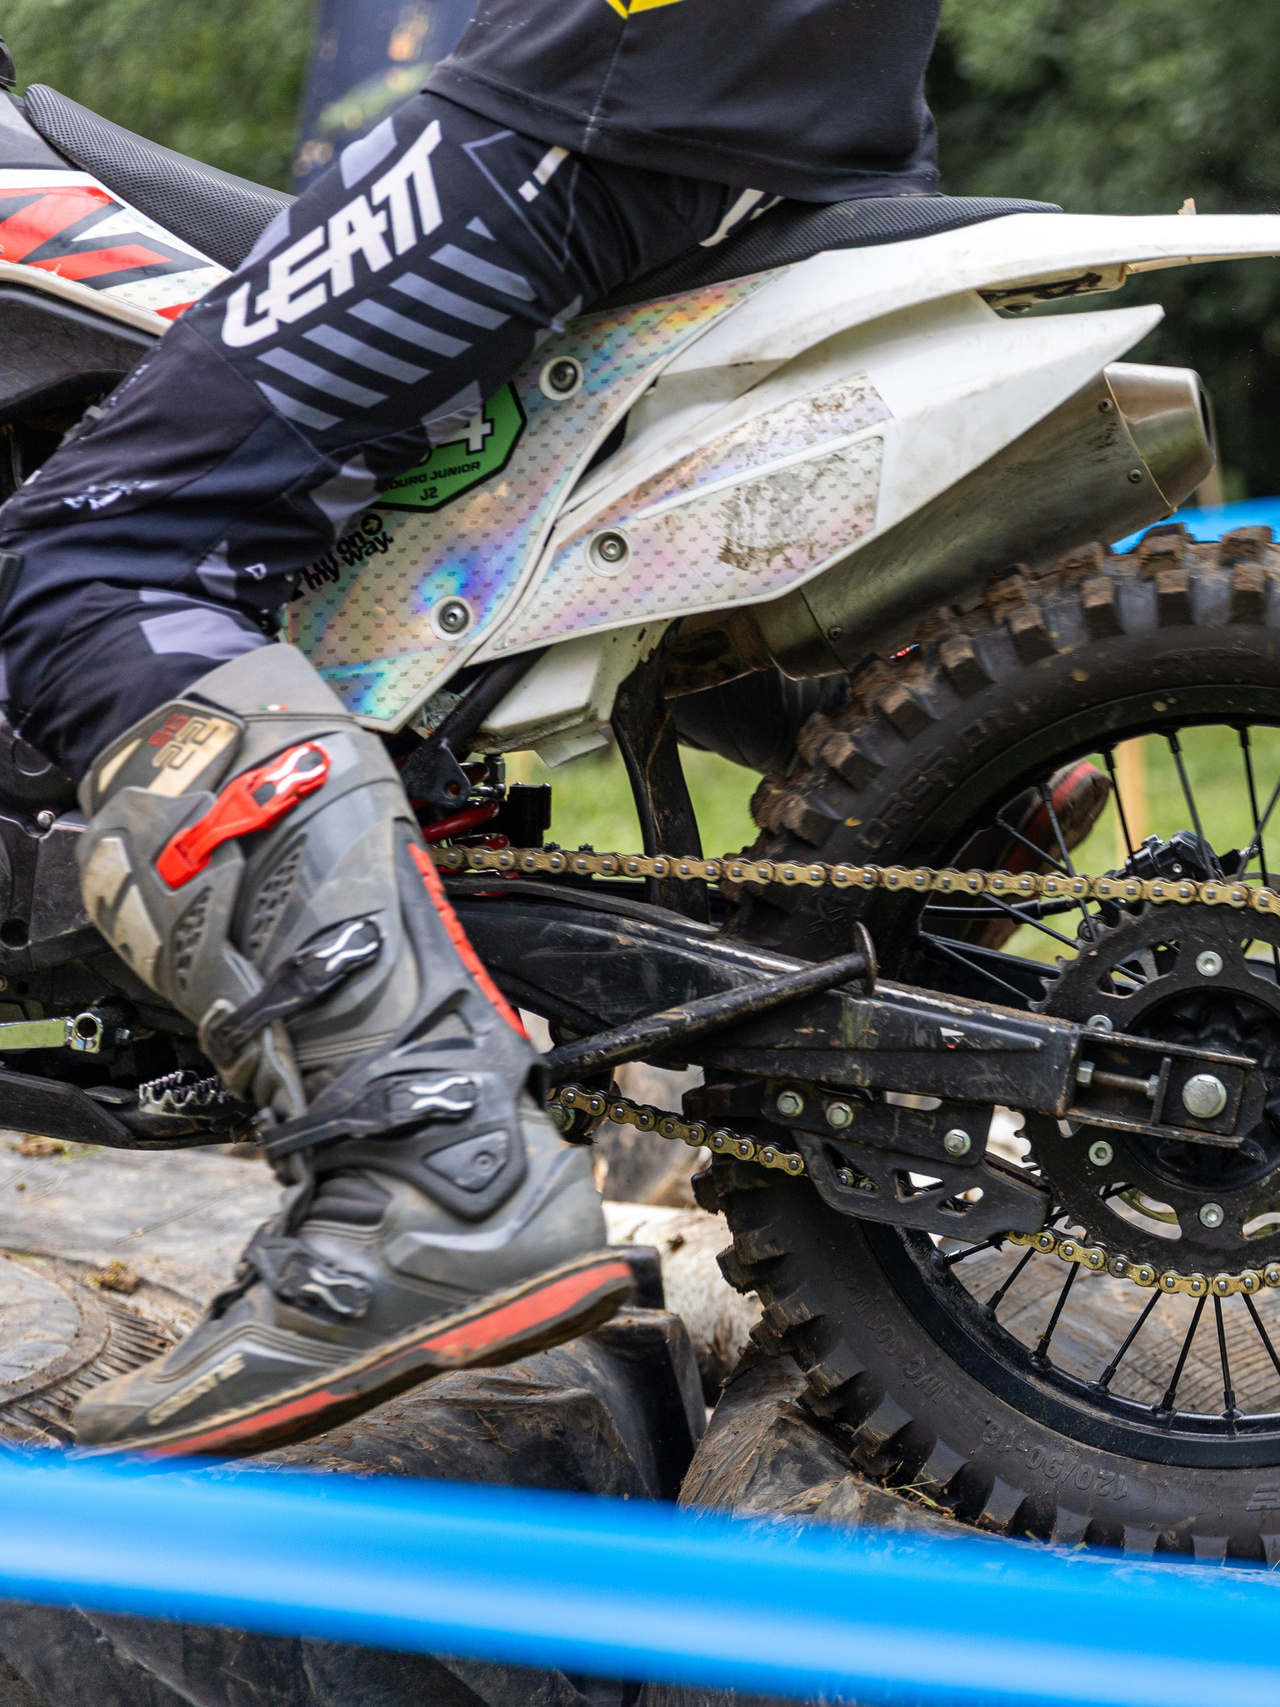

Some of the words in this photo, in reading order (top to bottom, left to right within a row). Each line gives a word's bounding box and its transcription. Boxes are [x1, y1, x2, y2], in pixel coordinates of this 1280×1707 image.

[221, 120, 443, 347] LEATT
[430, 460, 481, 481] JUNIOR
[420, 486, 438, 501] J2
[151, 715, 220, 771] 22
